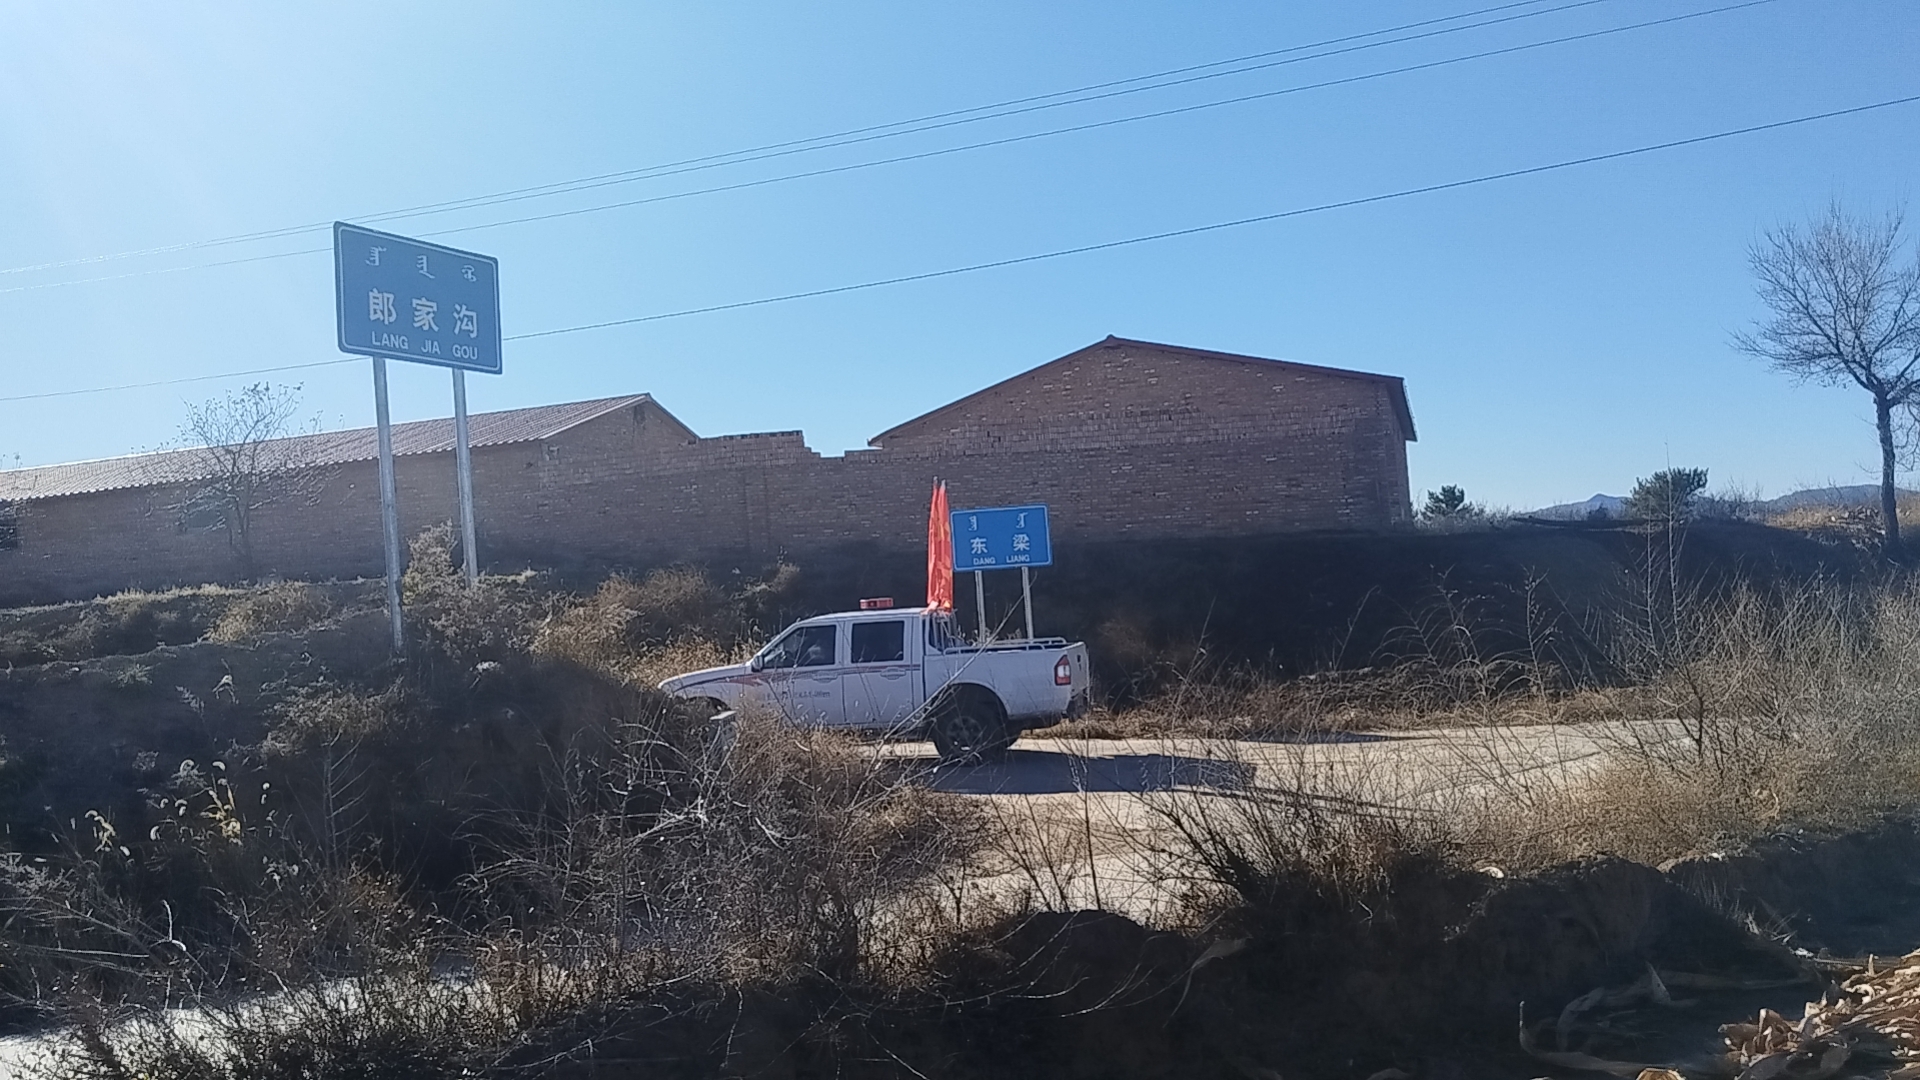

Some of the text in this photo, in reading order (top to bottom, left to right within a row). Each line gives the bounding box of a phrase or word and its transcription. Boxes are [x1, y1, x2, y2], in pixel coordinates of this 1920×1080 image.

[368, 287, 479, 339] 郎家沟
[371, 331, 478, 361] LANG JIA GOU
[970, 533, 1031, 555] 东梁
[973, 554, 1031, 566] DANG LIANG
